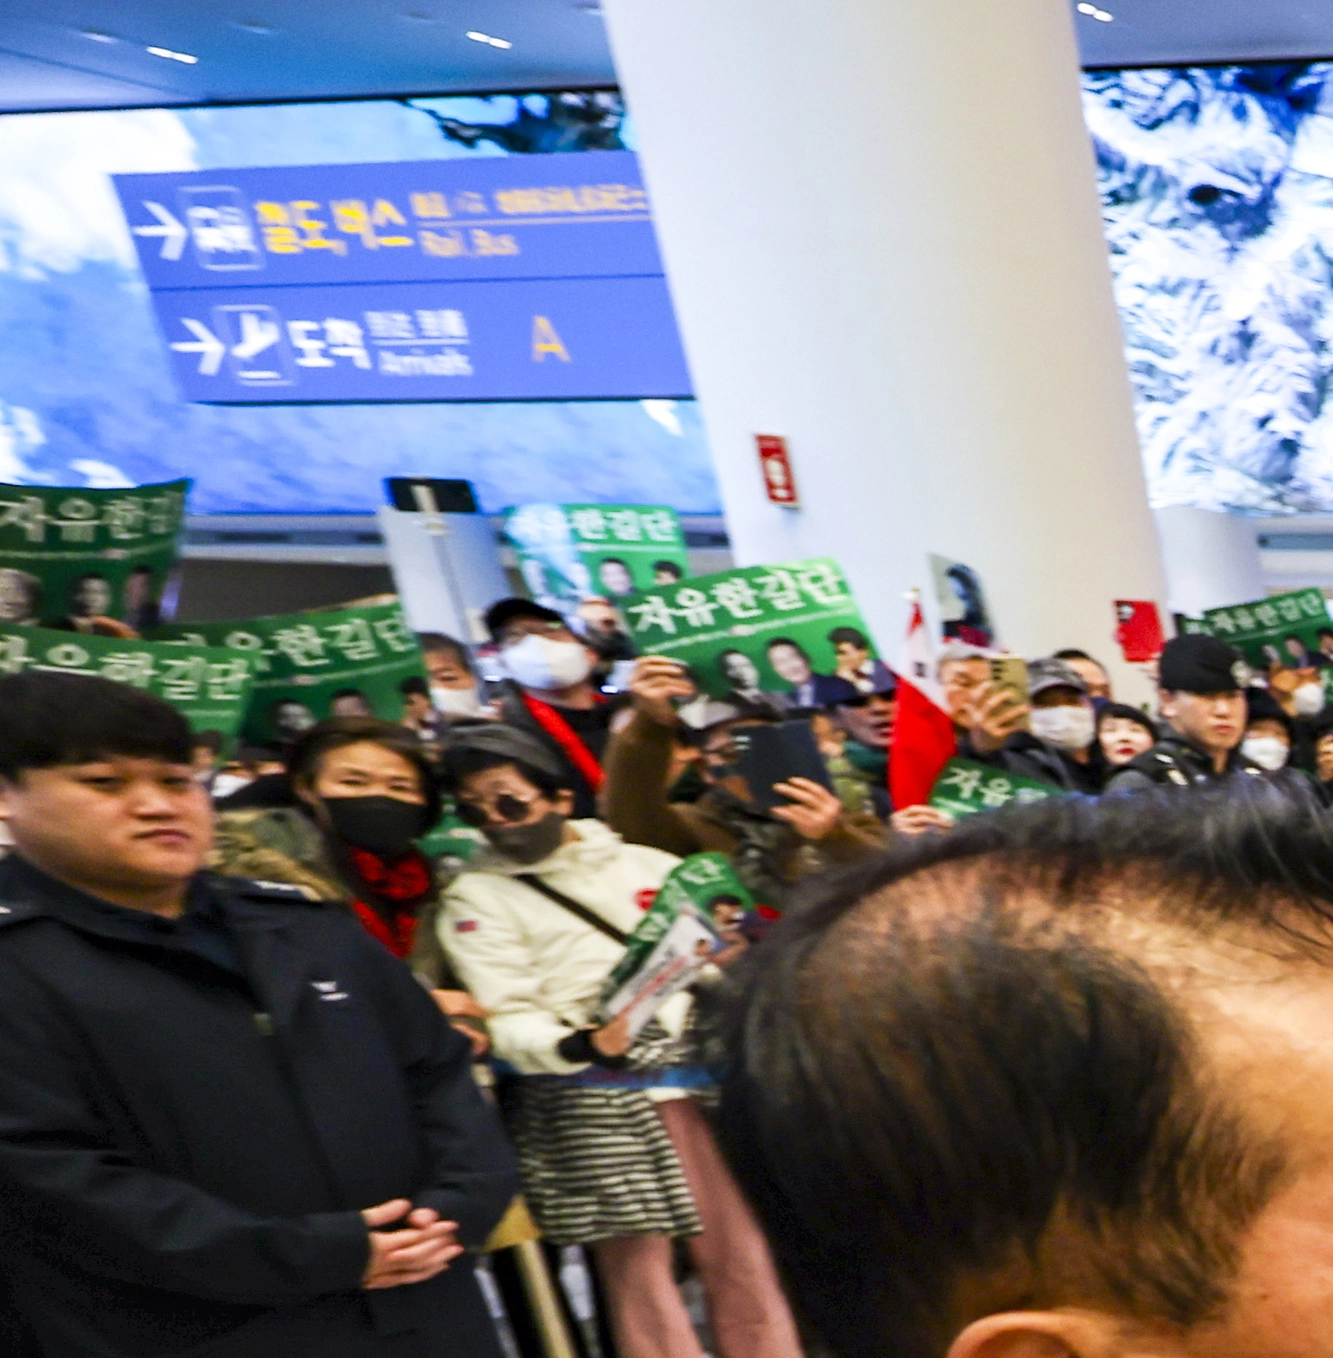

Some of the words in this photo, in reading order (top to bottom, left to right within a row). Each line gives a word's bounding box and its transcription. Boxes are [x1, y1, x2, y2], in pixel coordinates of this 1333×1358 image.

[287, 317, 372, 370] 도착
[532, 316, 572, 363] A
[628, 562, 848, 635] 자유한길단
